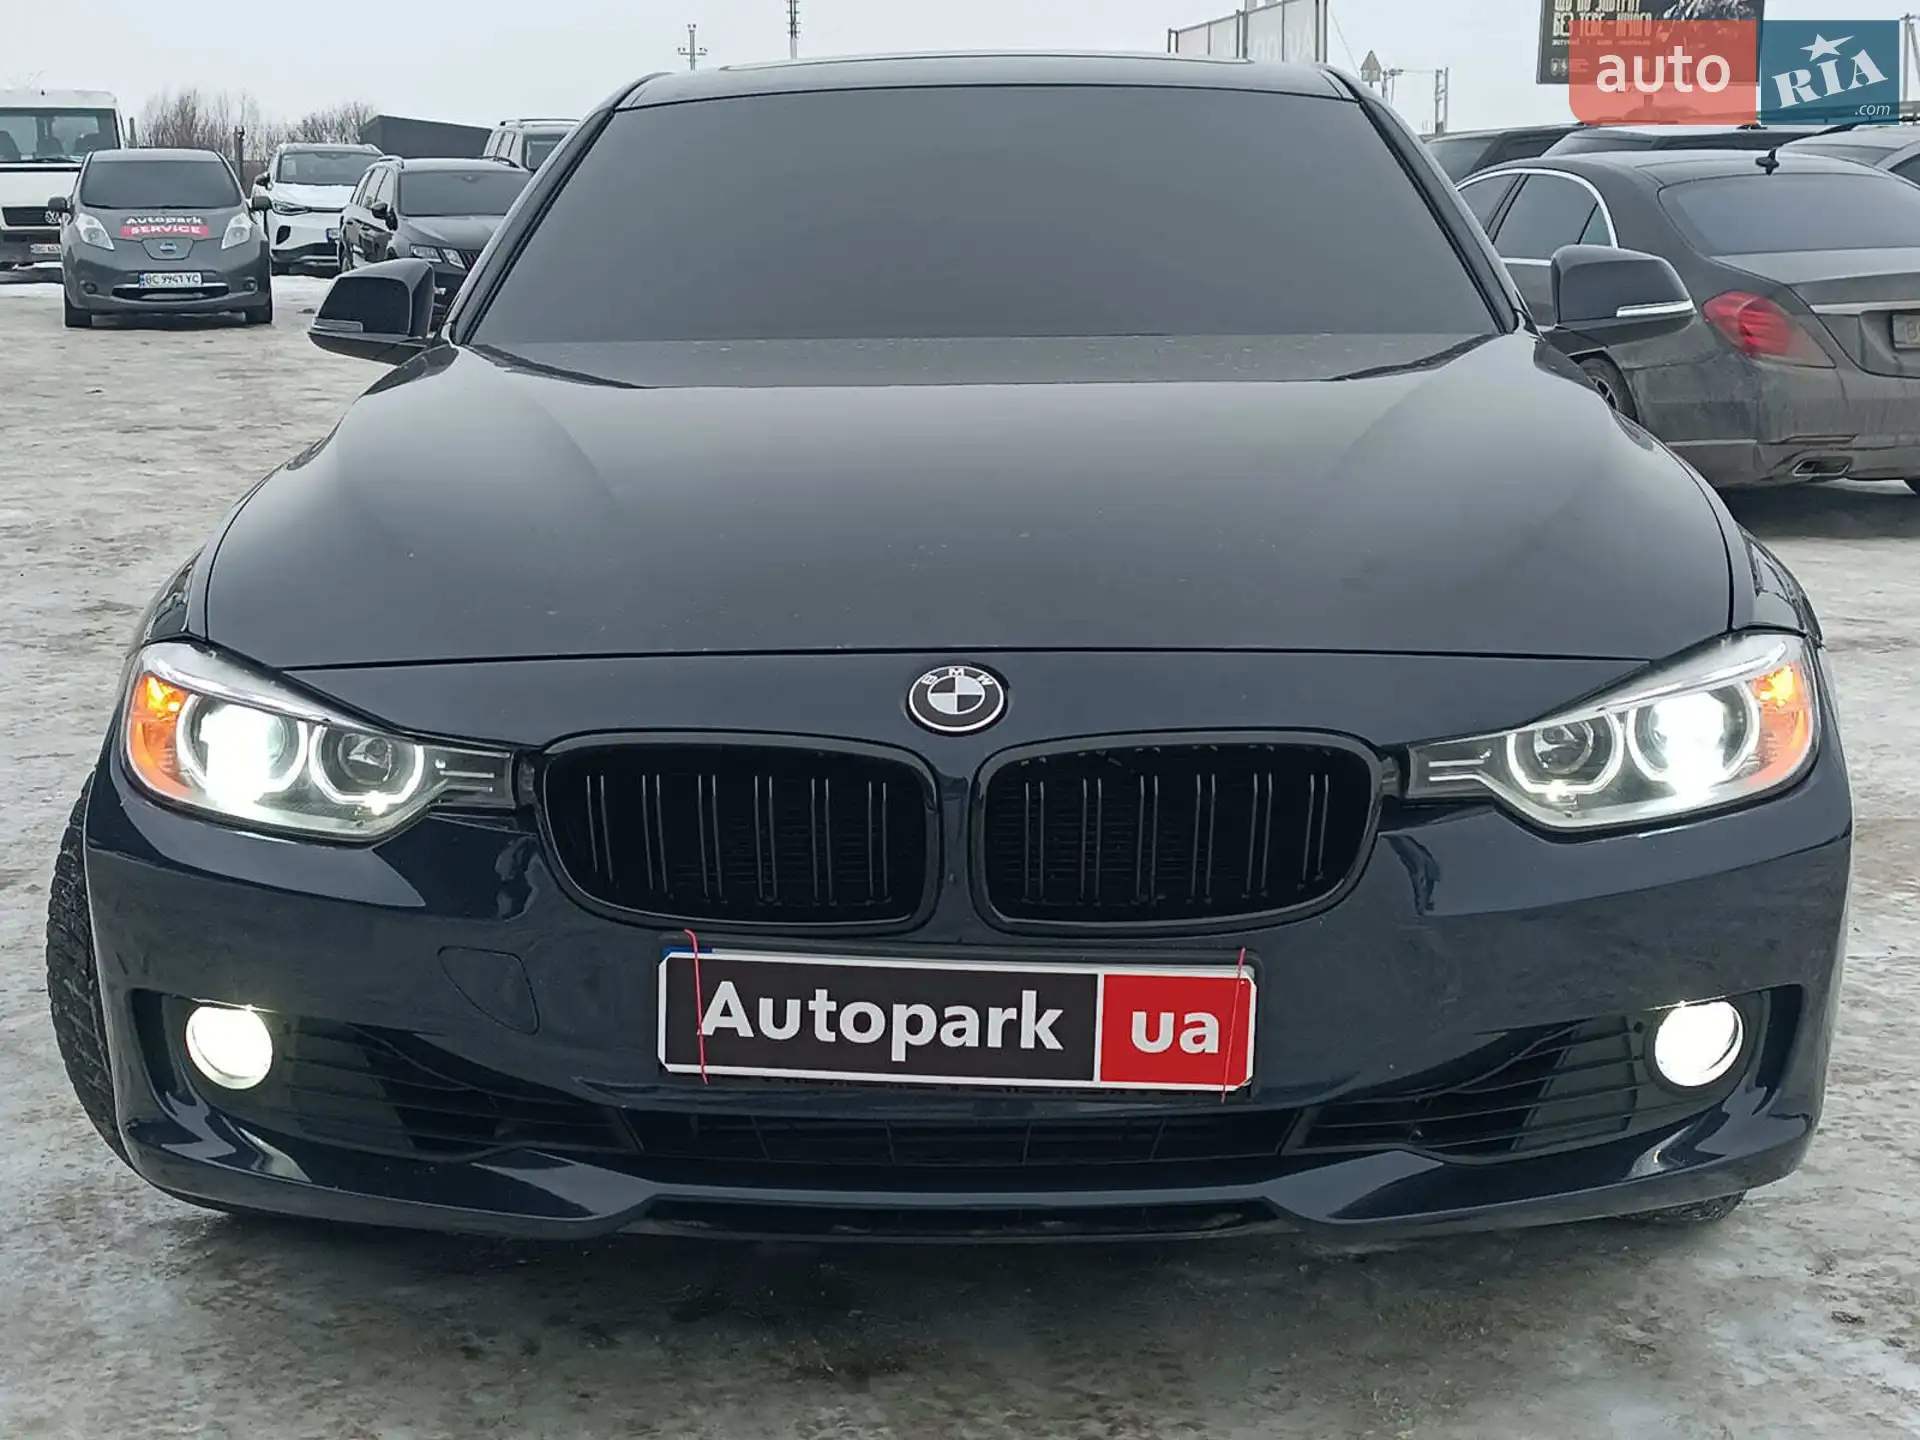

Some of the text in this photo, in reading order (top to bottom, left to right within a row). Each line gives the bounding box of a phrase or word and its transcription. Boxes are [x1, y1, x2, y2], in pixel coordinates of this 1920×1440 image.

[125, 215, 203, 225] Autopark
[130, 224, 201, 235] SERVICE
[921, 667, 994, 686] BMW
[700, 980, 1220, 1062] Autopark ua
